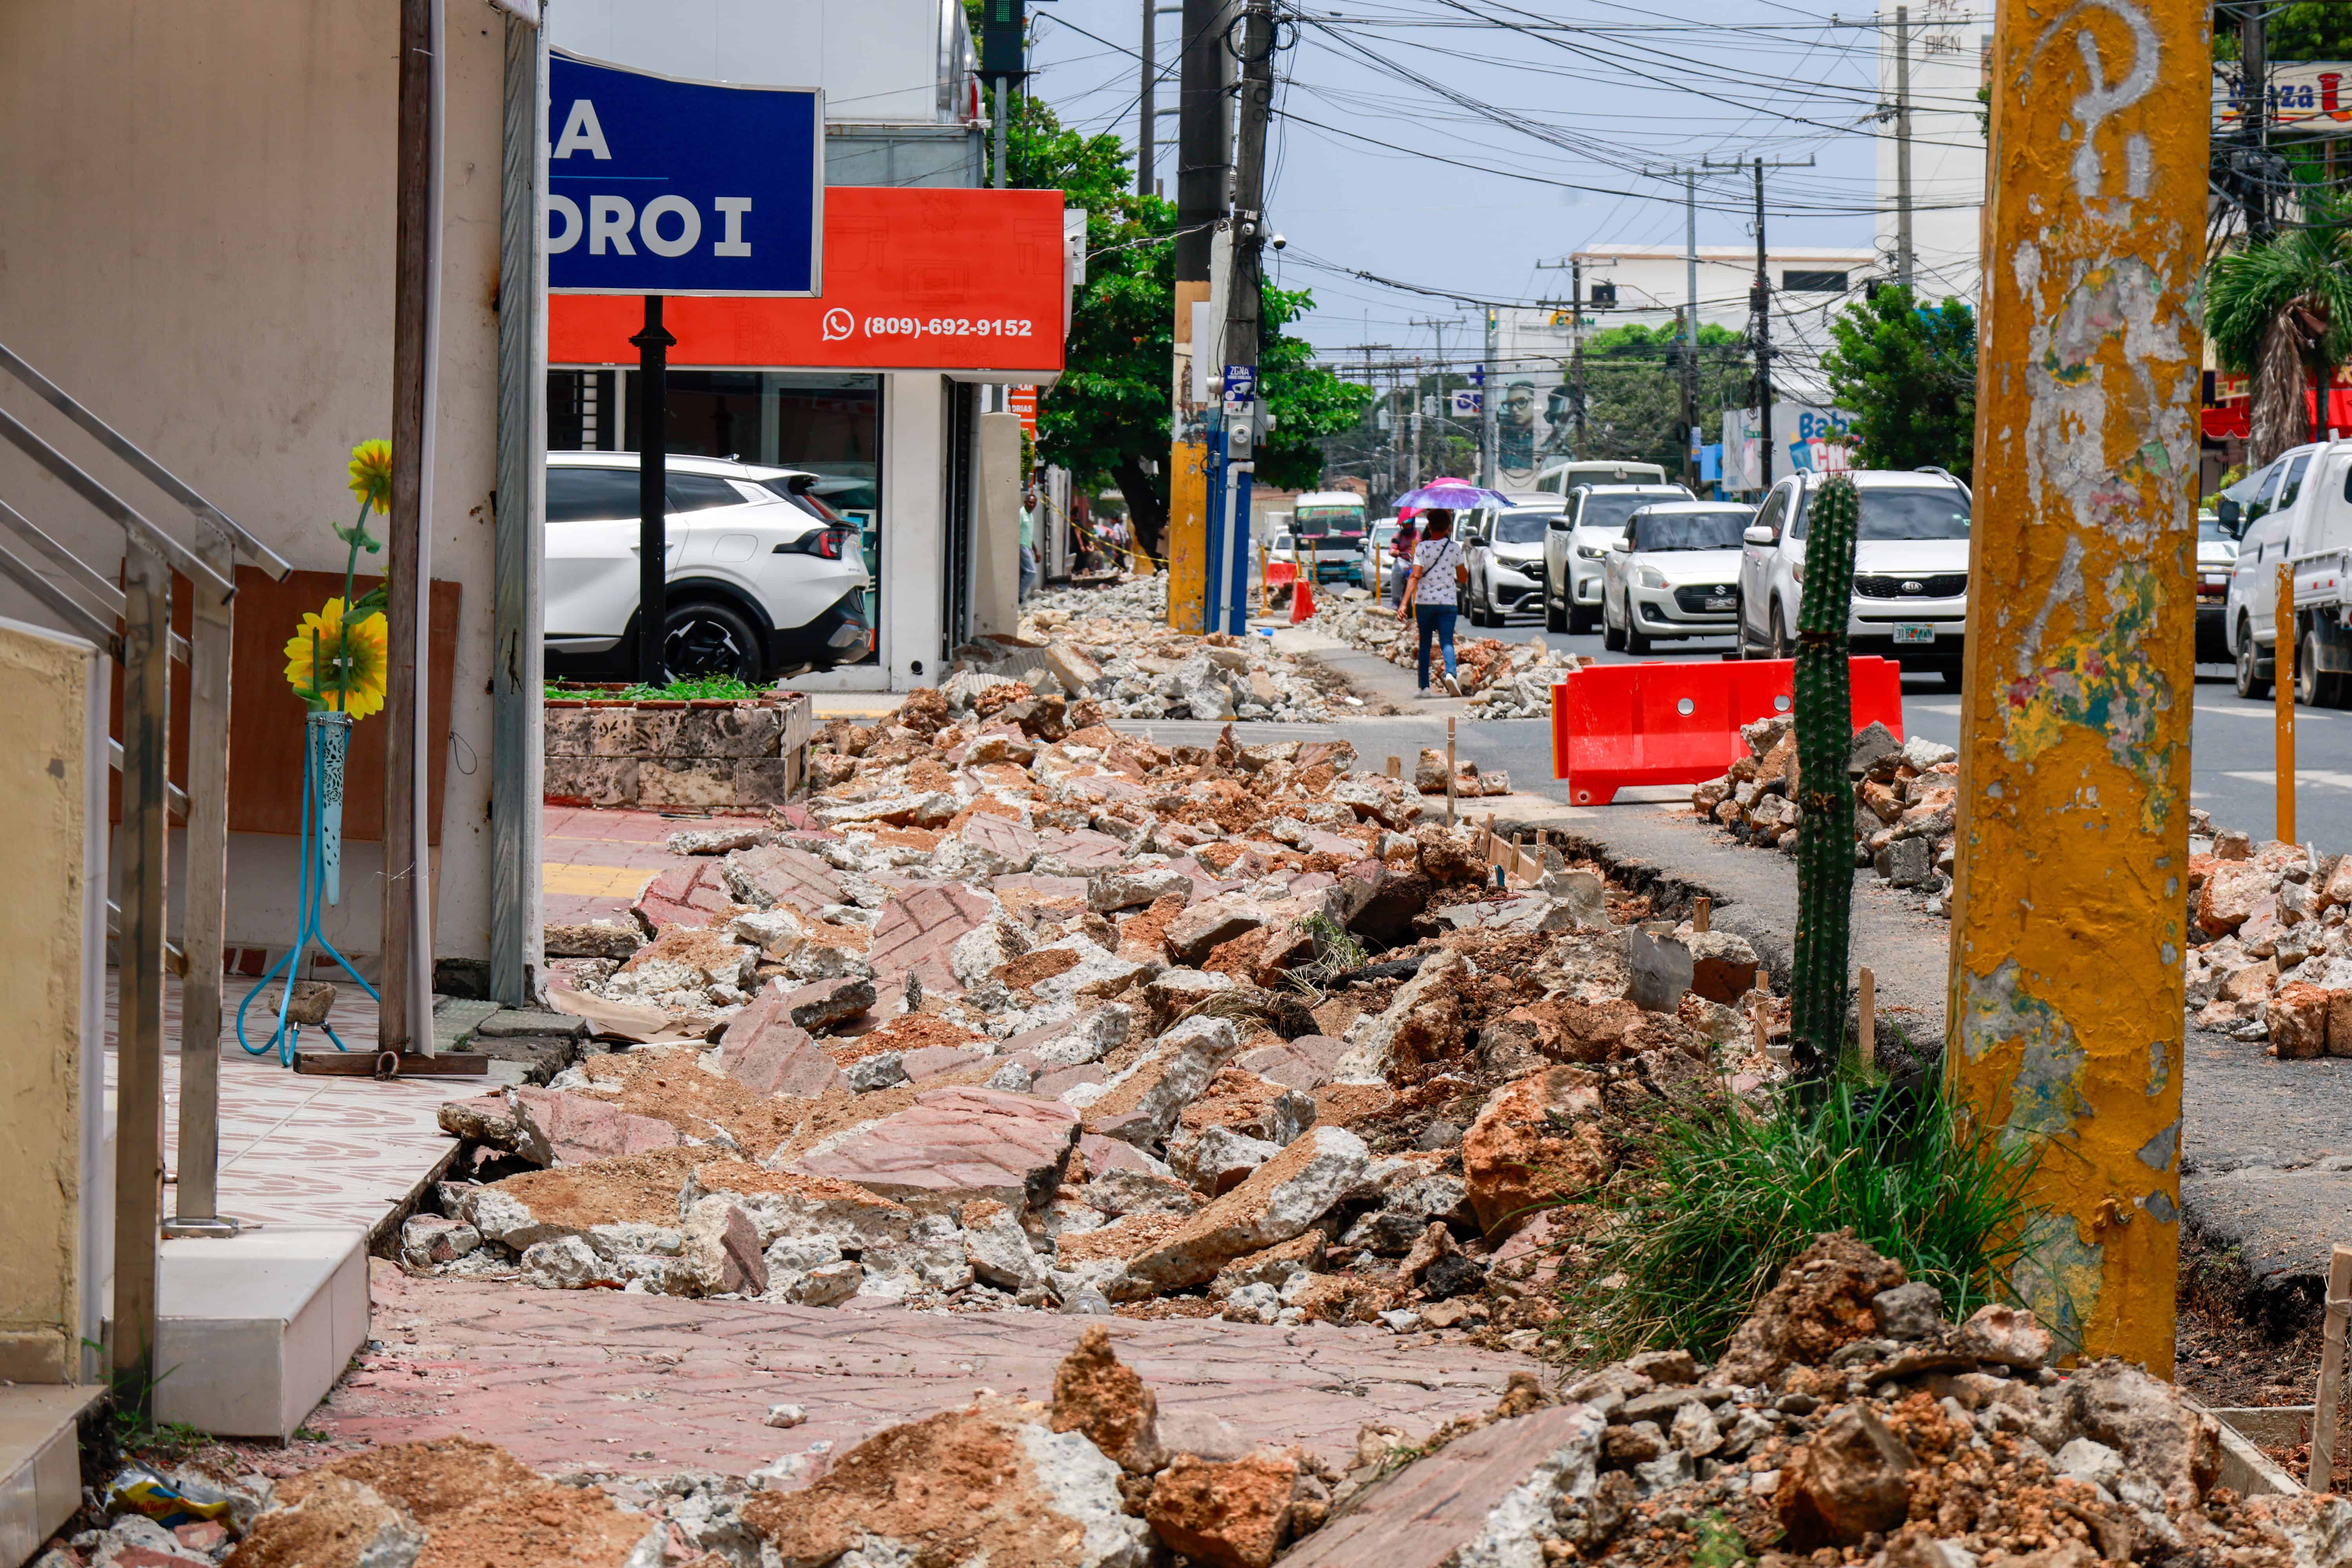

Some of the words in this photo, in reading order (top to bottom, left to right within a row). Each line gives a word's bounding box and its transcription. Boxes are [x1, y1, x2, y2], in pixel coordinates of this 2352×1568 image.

[1925, 35, 1960, 53] BIEN
[714, 197, 751, 256] I
[864, 317, 1032, 338] (809)-692-9152
